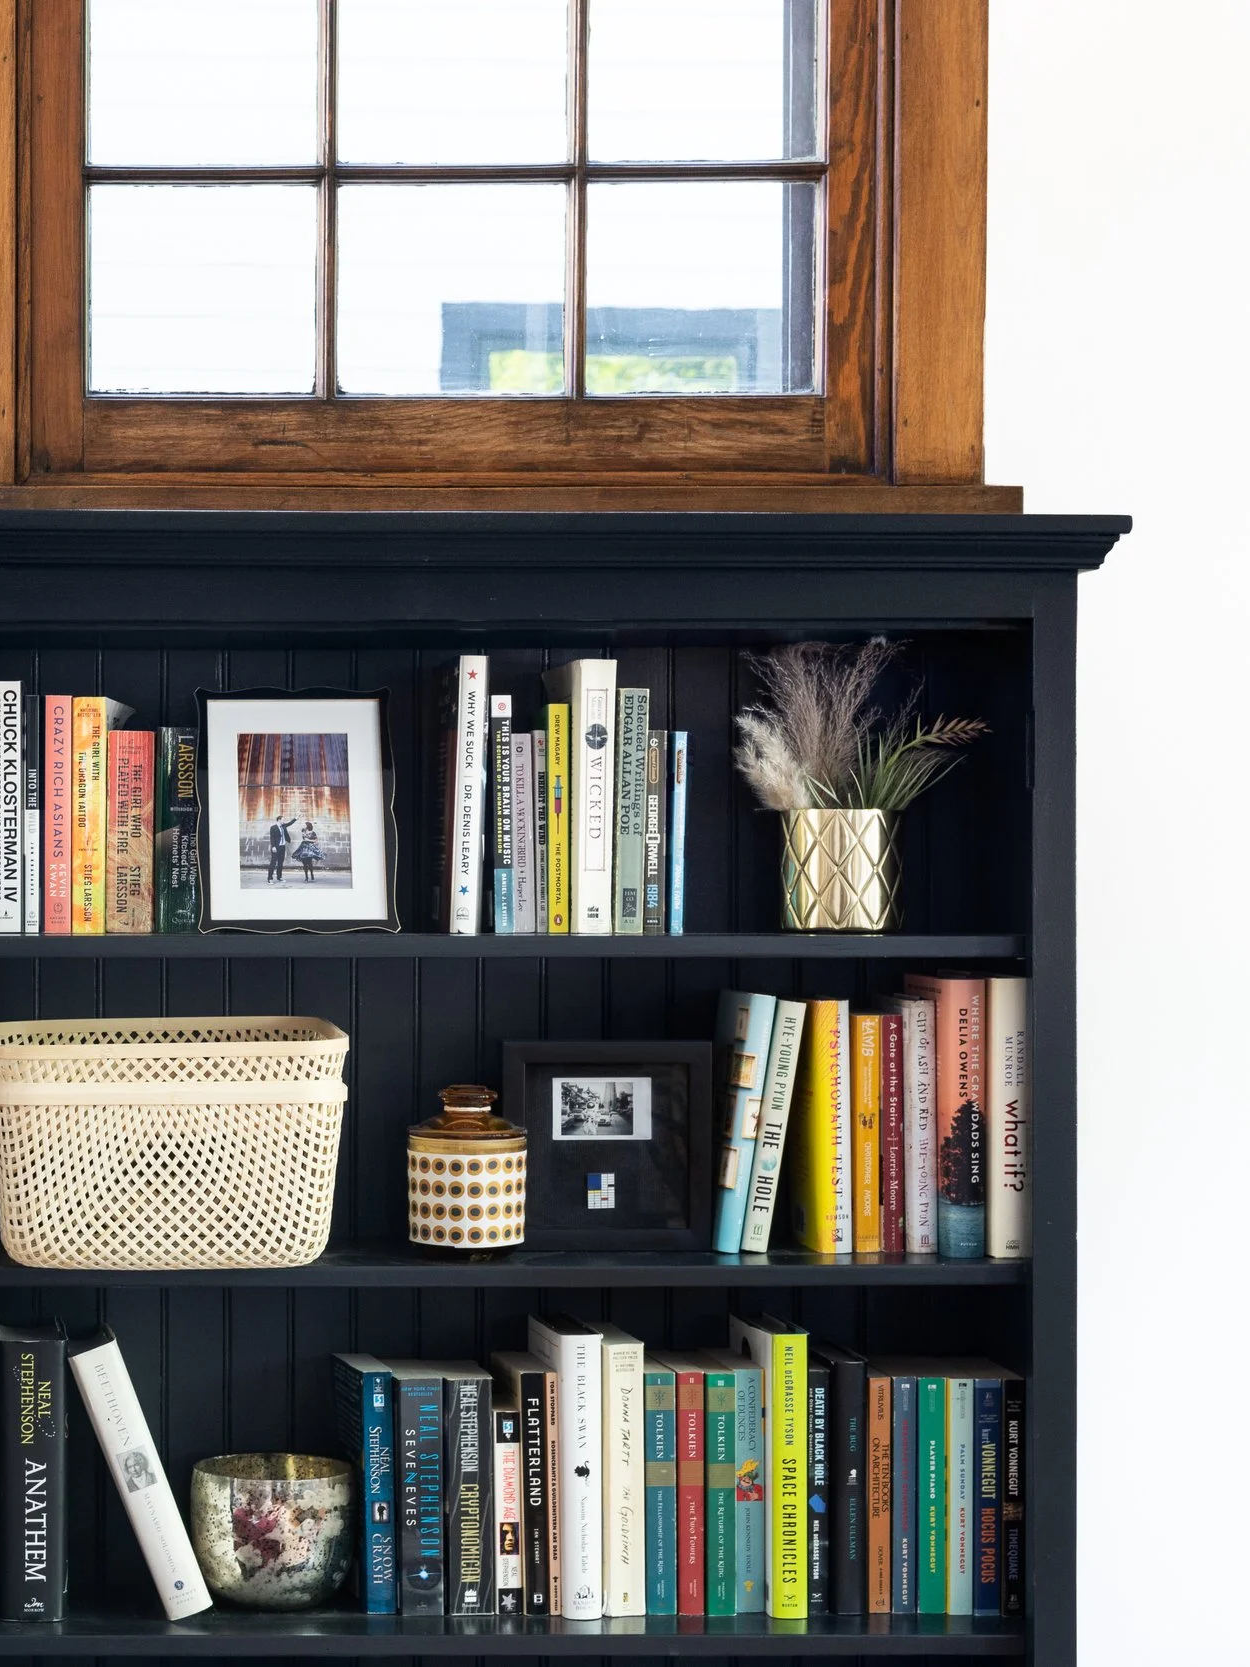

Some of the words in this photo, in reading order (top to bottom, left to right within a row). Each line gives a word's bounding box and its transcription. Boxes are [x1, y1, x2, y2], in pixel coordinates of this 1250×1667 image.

[467, 691, 476, 717] WHY
[4, 690, 17, 753] CHUCK
[53, 706, 63, 755] CRAZY
[466, 720, 475, 737] WE
[502, 720, 510, 743] THIS
[623, 695, 633, 747] EDGAR
[635, 695, 647, 752] Selected
[178, 736, 193, 797] LARSSON
[465, 741, 474, 768] SUCK
[502, 746, 510, 755] IS
[28, 769, 37, 789] INTO
[53, 761, 63, 797] RICH
[118, 758, 128, 796] PLAYED
[131, 764, 142, 783] THE
[502, 758, 510, 782] YOUR
[621, 750, 632, 800] ALLAN
[28, 792, 37, 808] THE
[131, 786, 142, 810] GIRL
[464, 785, 472, 802] DR.
[502, 786, 510, 815] BRAIN
[588, 756, 602, 840] WICKED
[632, 757, 645, 818] Writings
[4, 759, 17, 880] KLOSTERMAN
[118, 800, 128, 827] WITH
[131, 814, 141, 838] WHO
[462, 806, 472, 838] DENIS
[503, 818, 510, 831] ON
[620, 804, 631, 835] POE
[633, 823, 642, 836] of
[53, 803, 63, 858] ASIANS
[117, 831, 128, 854] FIRE
[180, 835, 189, 865] Kicked
[461, 841, 470, 875] LEARY
[49, 864, 57, 897] KWAN
[84, 864, 92, 885] STIEG
[116, 866, 128, 913] LARSSON
[130, 866, 141, 895] STIEG
[180, 868, 189, 881] the
[4, 887, 17, 902] IV
[84, 888, 92, 922] LARSSON
[647, 884, 658, 908] 1984
[959, 1008, 967, 1046] DELIA
[971, 995, 979, 1040] WHERE
[776, 1017, 797, 1077] HYE-YOUNG
[889, 1034, 897, 1057] Gate
[971, 1045, 979, 1070] THE
[1005, 1037, 1013, 1087] MUNROE
[1016, 1031, 1025, 1087] RANDALL
[889, 1062, 897, 1073] at
[959, 1052, 967, 1098] OWENS
[771, 1082, 786, 1111] PYUN
[829, 1029, 843, 1146] PSYCHOPATH
[889, 1077, 897, 1092] the
[889, 1097, 897, 1127] Stairs
[971, 1075, 980, 1148] CRAWDADS
[1004, 1099, 1026, 1157] what
[762, 1123, 783, 1149] THE
[831, 1154, 843, 1199] TEST
[889, 1147, 898, 1177] Lorrie
[971, 1153, 980, 1184] SING
[1004, 1163, 1026, 1192] if?
[753, 1175, 774, 1213] HOLE
[889, 1180, 898, 1210] Moore
[577, 1344, 586, 1368] THE
[784, 1346, 794, 1366] NEIL
[20, 1353, 34, 1444] STEPHENSON
[38, 1381, 51, 1419] NEAL
[94, 1363, 133, 1447] BEETHOVEN
[460, 1385, 476, 1409] NEAL
[577, 1375, 586, 1412] BLACK
[814, 1388, 824, 1416] DEATH
[419, 1404, 439, 1442] NEAL
[578, 1418, 587, 1449] SWAN
[656, 1413, 664, 1459] TOLKIEN
[688, 1412, 697, 1458] TOLKIEN
[717, 1415, 726, 1461] TOLKIEN
[784, 1418, 794, 1446] TYSON
[814, 1419, 824, 1430] BY
[849, 1417, 857, 1433] THE
[1008, 1420, 1018, 1444] KURT
[461, 1411, 478, 1472] STEPHENSON
[528, 1398, 542, 1506] FLATTERLAND
[814, 1433, 824, 1460] BLACK
[849, 1435, 857, 1452] BUG
[872, 1438, 880, 1452] ON
[369, 1426, 382, 1494] STEPHENSON
[380, 1447, 389, 1475] NEAL
[814, 1463, 824, 1486] HOLE
[981, 1444, 996, 1499] VONNEGUT
[1008, 1447, 1018, 1496] VONNEGUT
[403, 1430, 418, 1526] SEVENEVES
[782, 1458, 796, 1497] SPACE
[872, 1455, 880, 1518] ARCHITECTURE
[24, 1458, 46, 1582] ANATHEM
[420, 1454, 440, 1557] STEPHENSON
[461, 1483, 480, 1583] CRYPTONOMICON
[981, 1508, 995, 1543] HOCUS
[372, 1533, 383, 1584] CRASH
[383, 1536, 392, 1583] SNOW
[782, 1504, 797, 1584] CHRONICLES
[1008, 1528, 1018, 1580] TIMEQUAKE
[981, 1548, 995, 1583] POCUS
